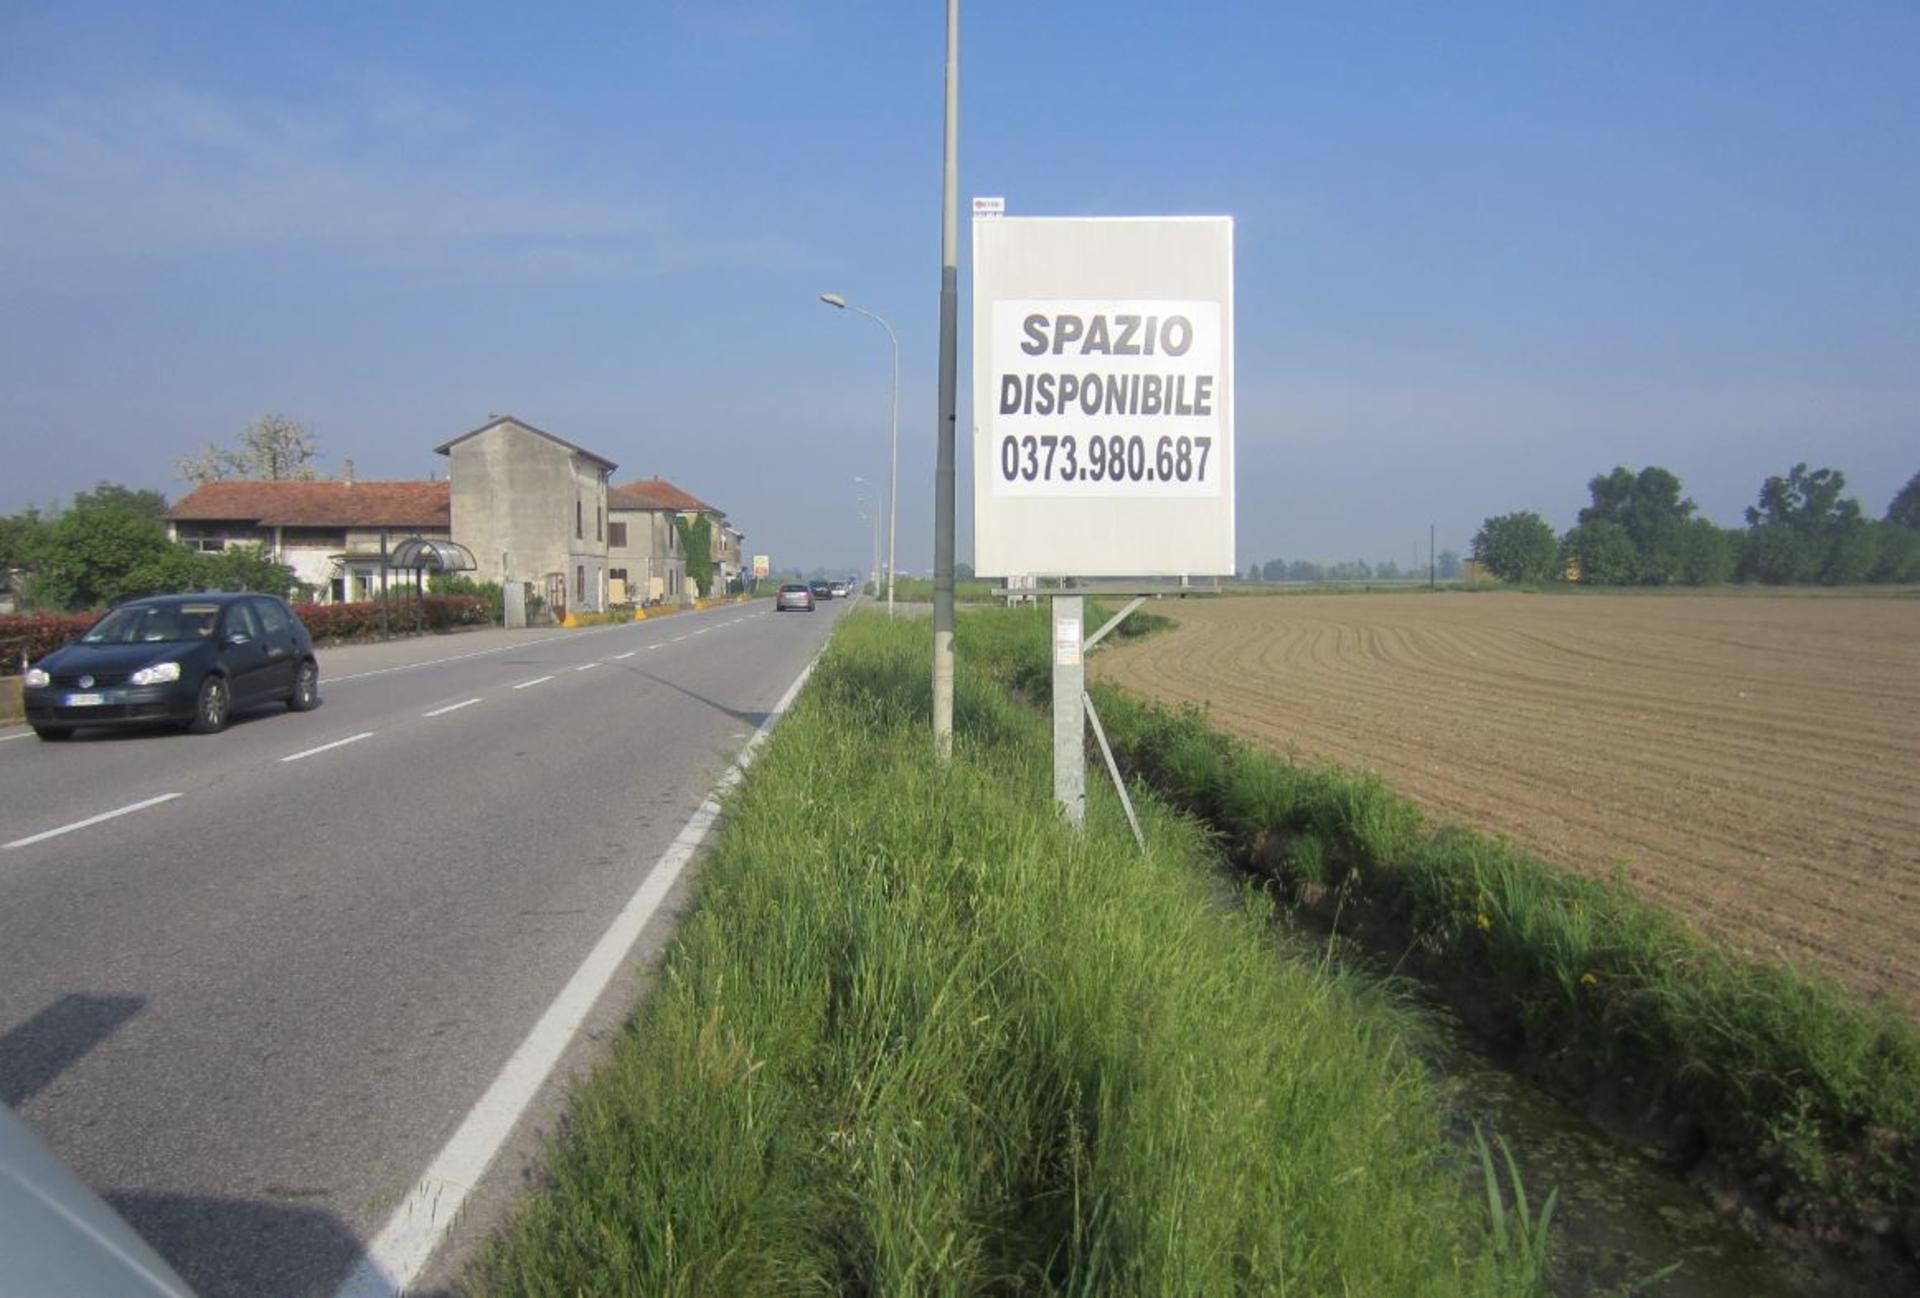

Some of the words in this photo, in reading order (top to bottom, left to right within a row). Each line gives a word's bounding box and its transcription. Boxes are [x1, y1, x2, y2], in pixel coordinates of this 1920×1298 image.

[1021, 314, 1193, 357] SPAZIO
[999, 373, 1213, 417] DISPONIBILE
[1001, 434, 1212, 482] 0373.980.687
